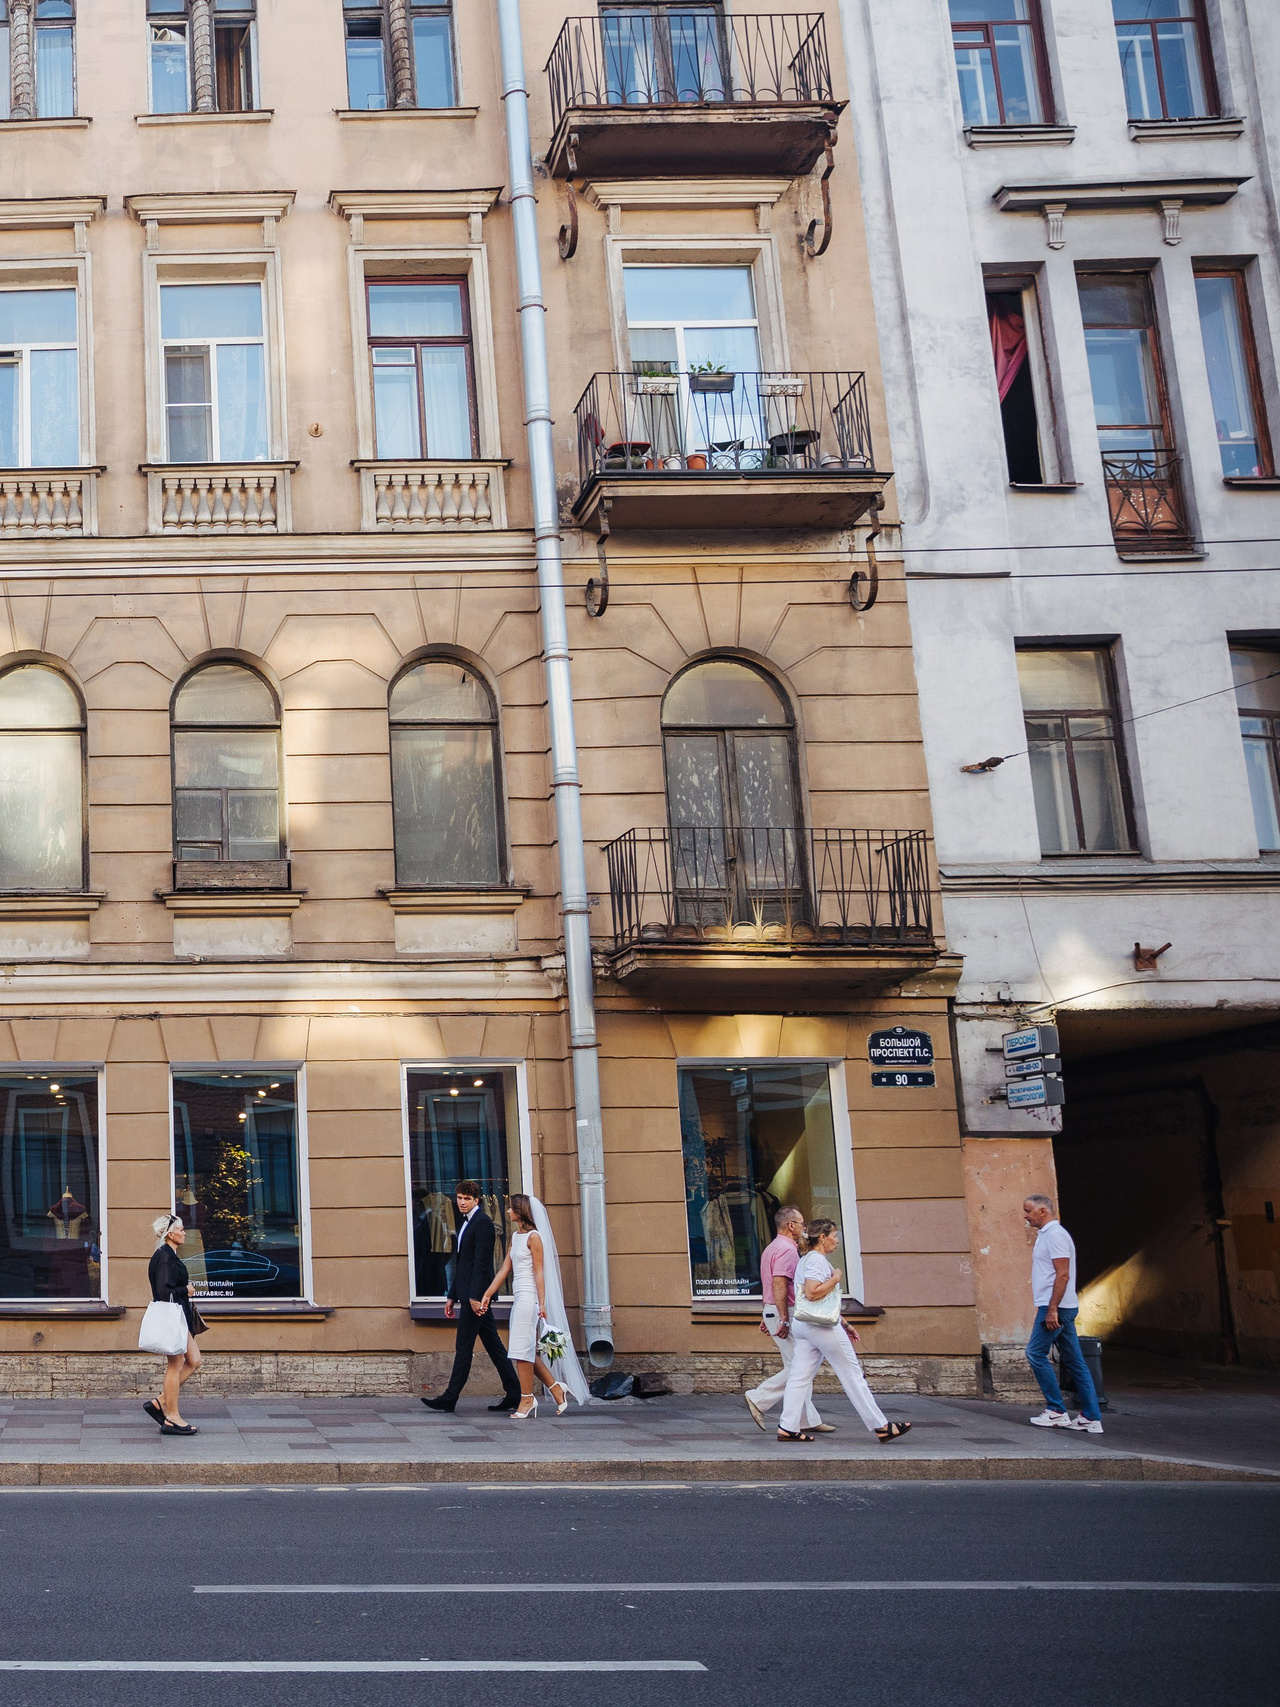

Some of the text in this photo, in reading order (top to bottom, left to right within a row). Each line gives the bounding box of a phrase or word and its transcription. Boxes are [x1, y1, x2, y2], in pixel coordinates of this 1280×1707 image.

[880, 1037, 921, 1047] БОЛЬШОЙ
[1007, 1034, 1036, 1048] ПЕРСОНА
[871, 1049, 932, 1057] ПРОСПЕКТ П.С.
[895, 1074, 908, 1085] 90
